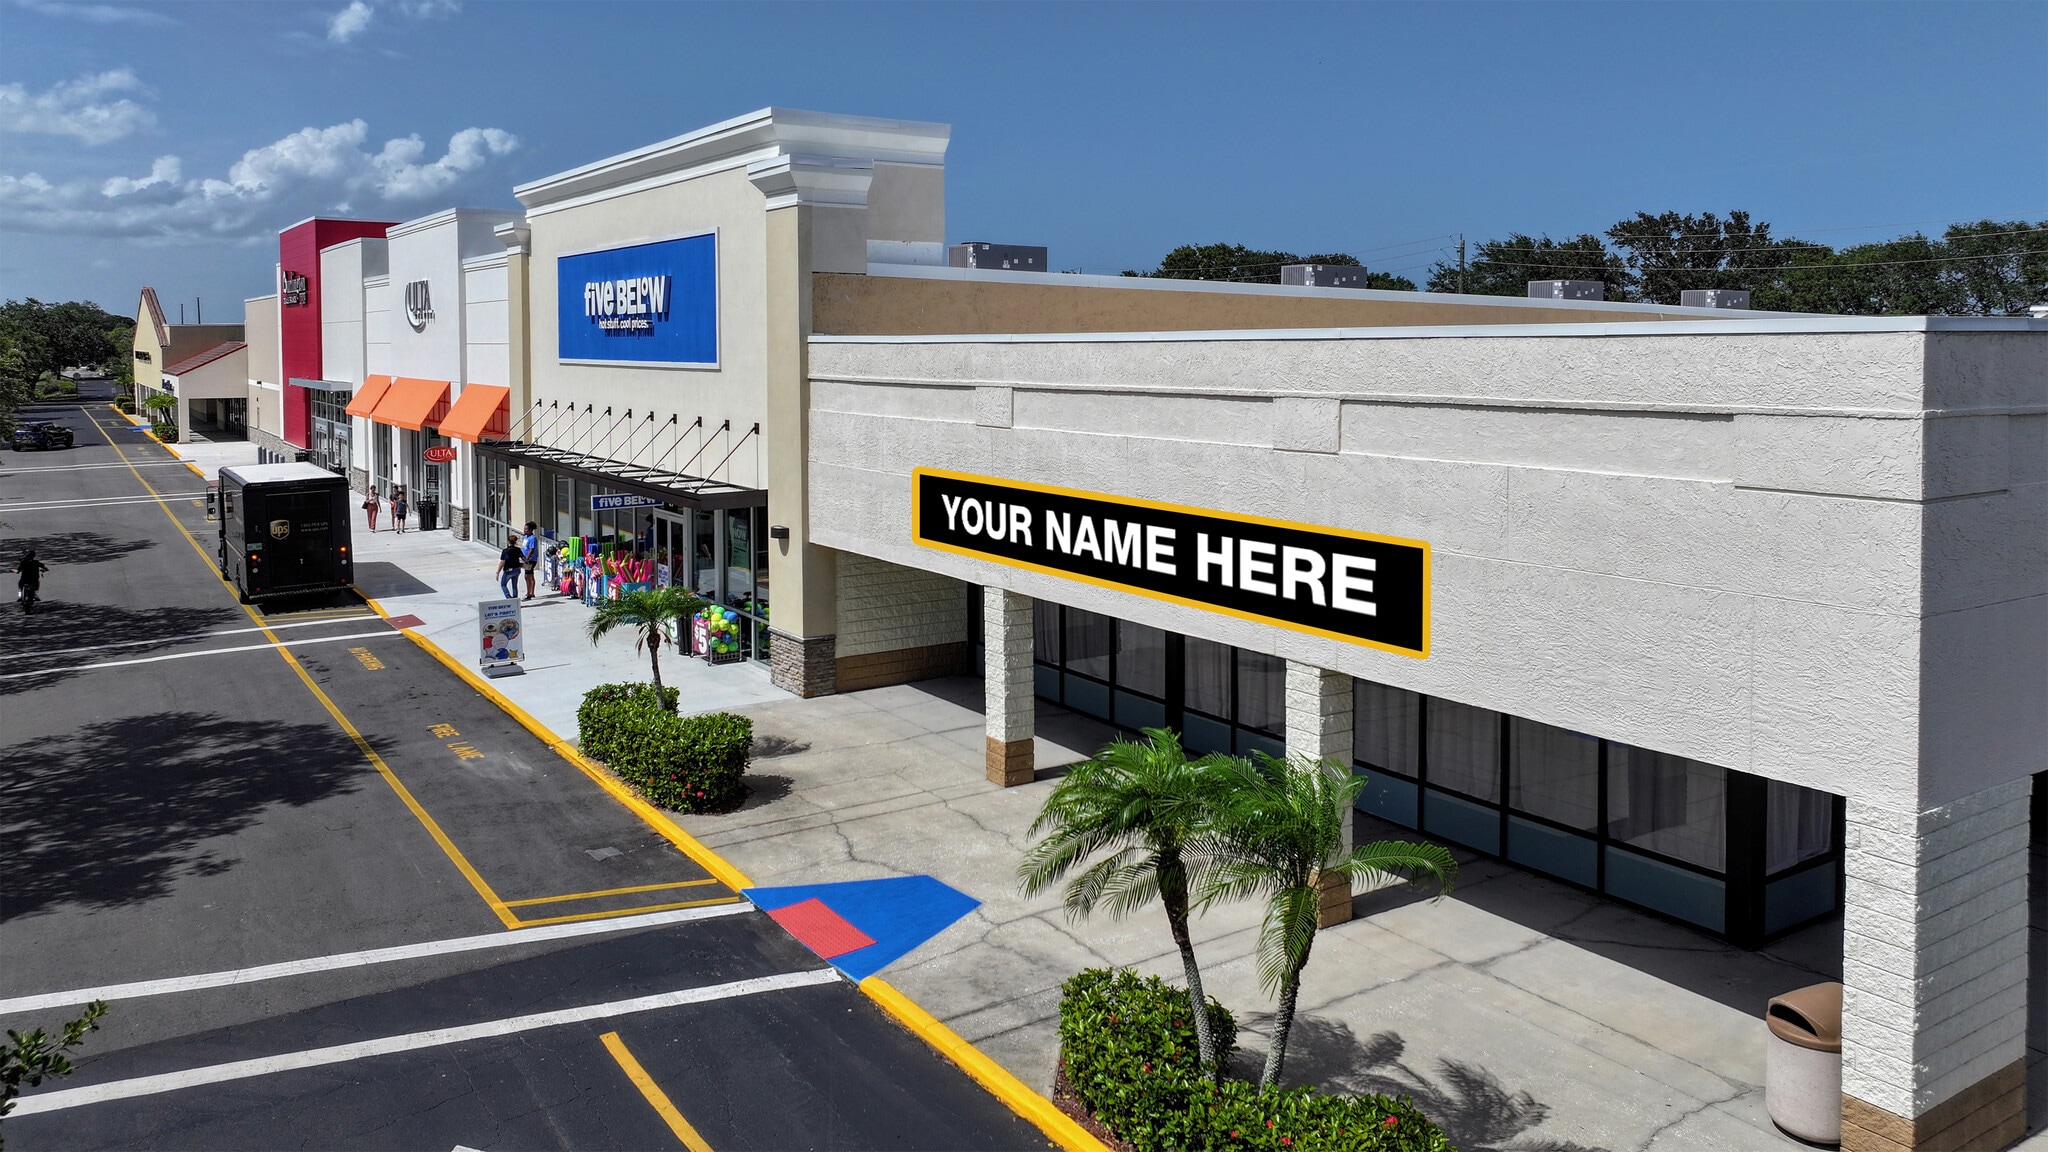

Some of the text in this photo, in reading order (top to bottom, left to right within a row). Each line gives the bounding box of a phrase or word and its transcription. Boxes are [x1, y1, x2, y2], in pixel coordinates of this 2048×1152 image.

[616, 275, 665, 315] BELOW
[430, 449, 452, 458] ULTA
[599, 497, 622, 507] five
[272, 525, 288, 537] ups
[941, 493, 1378, 617] YOUR NAME HERE
[694, 624, 707, 654] $5
[427, 722, 485, 760] FIRE LANE
